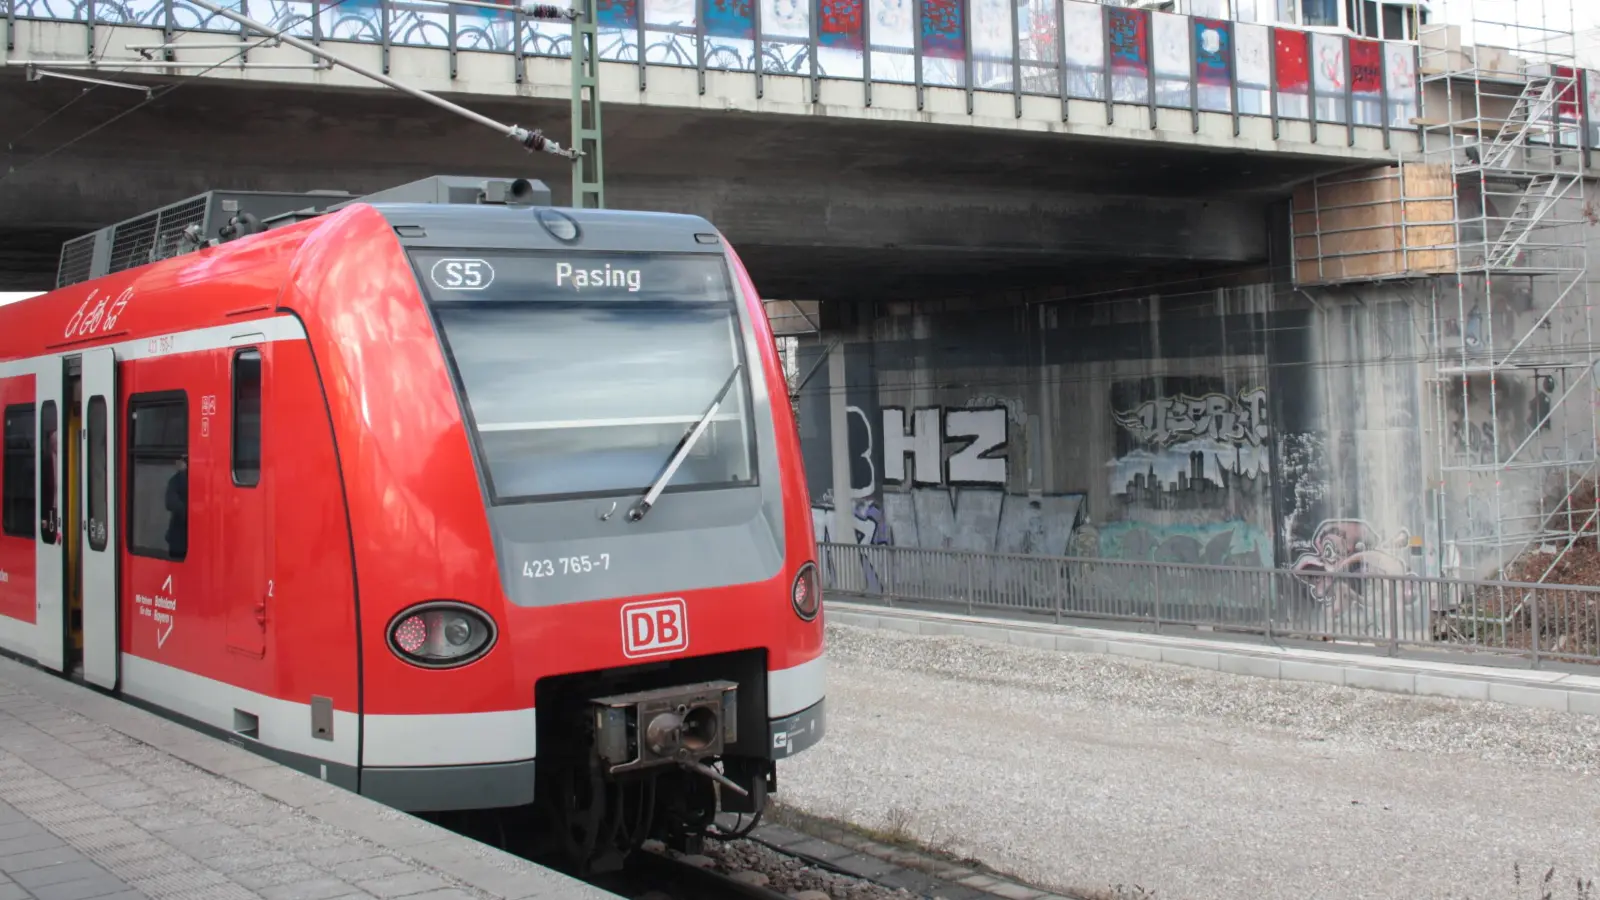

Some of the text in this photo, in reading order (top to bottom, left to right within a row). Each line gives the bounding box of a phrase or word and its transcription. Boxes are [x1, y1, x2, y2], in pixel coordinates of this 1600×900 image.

[445, 262, 641, 292] S5 Pasing
[882, 405, 1008, 487] HZ
[522, 553, 610, 578] 423 765-7
[268, 579, 274, 597] 2
[629, 607, 681, 649] DB
